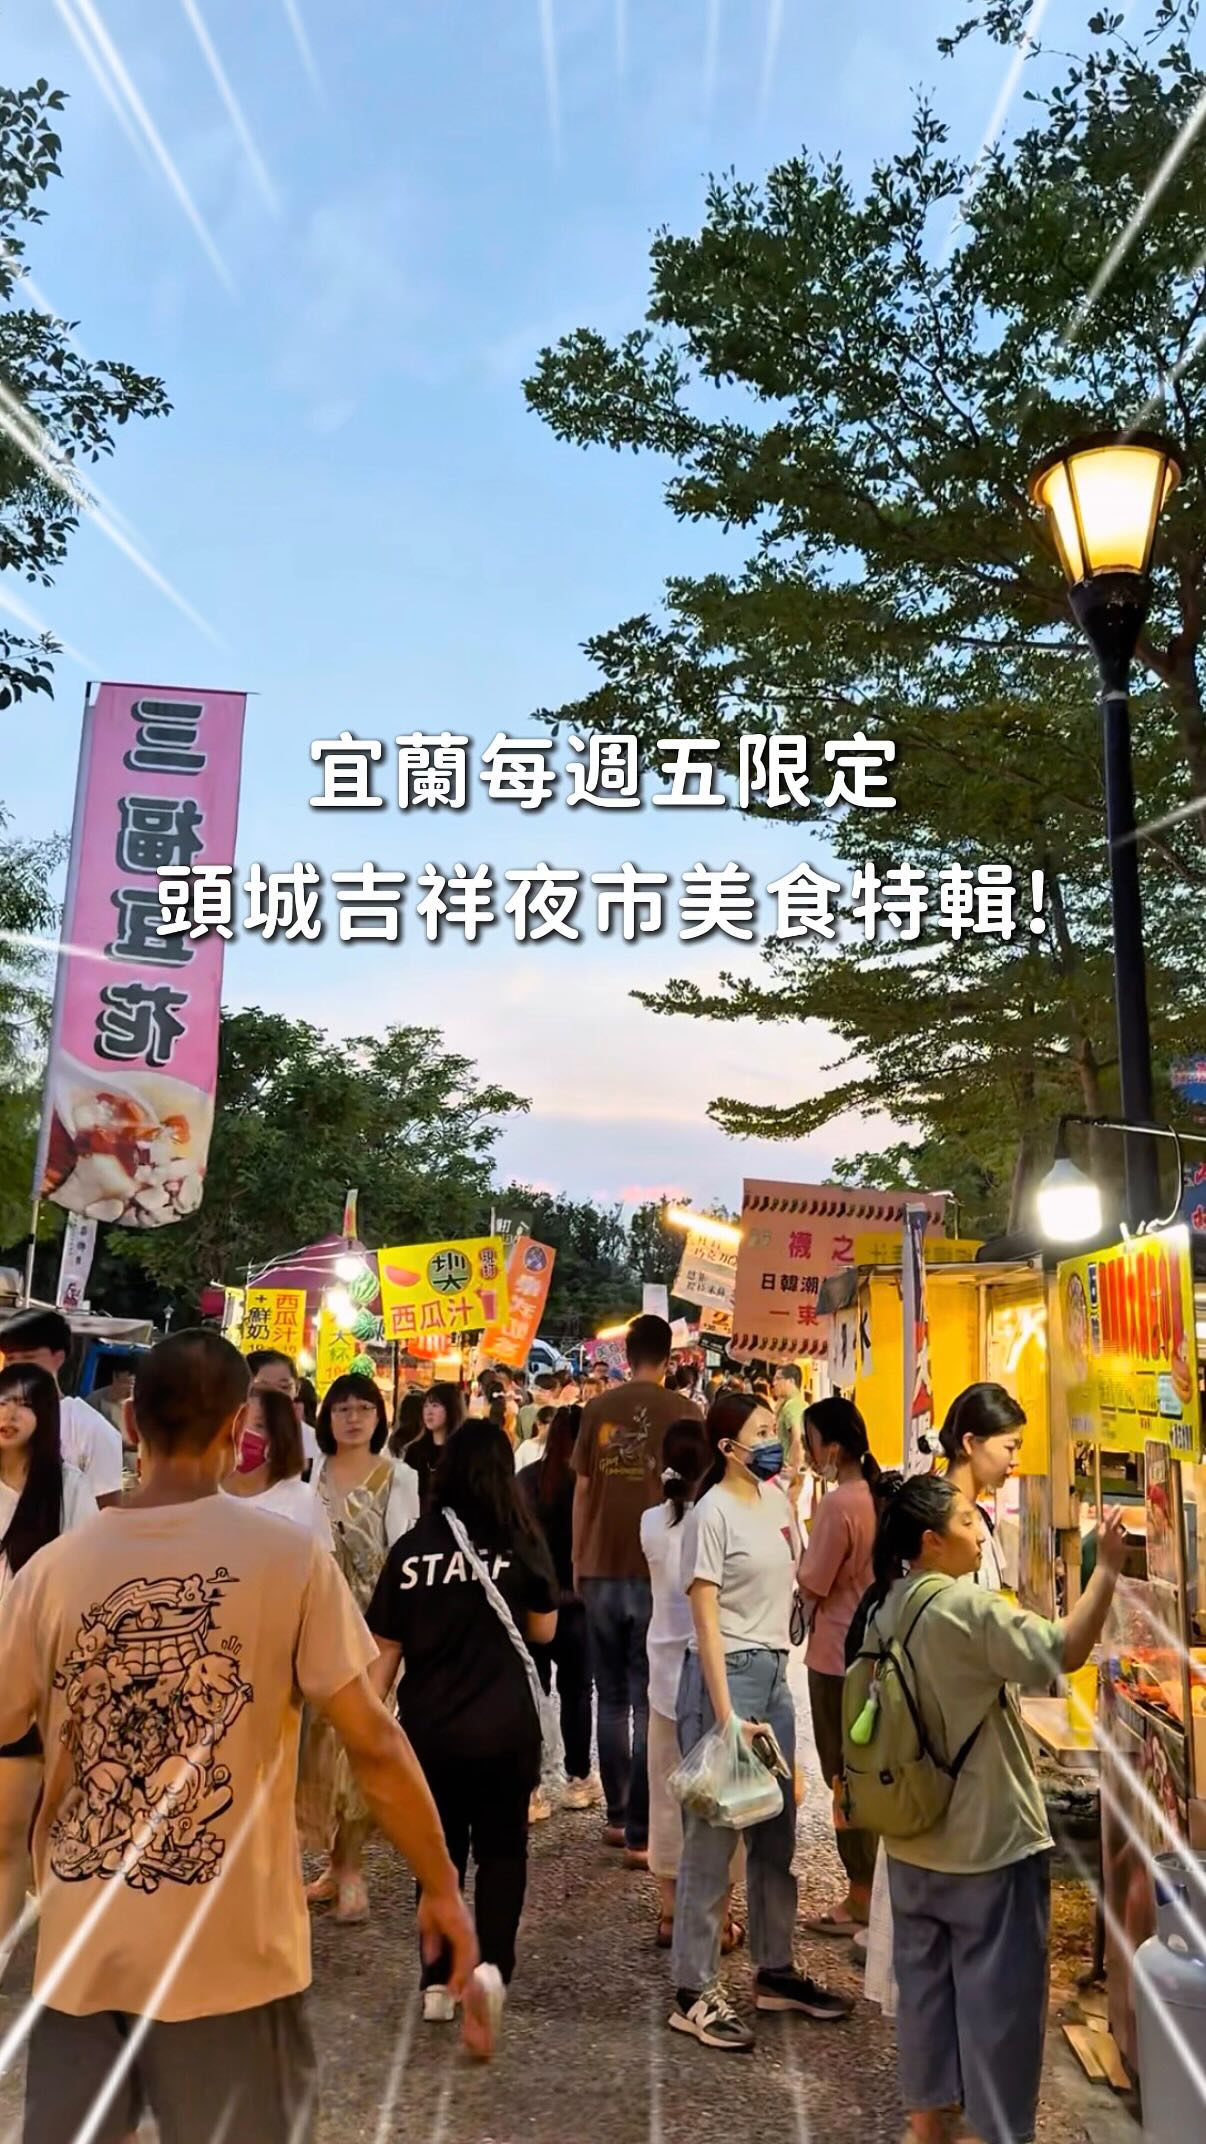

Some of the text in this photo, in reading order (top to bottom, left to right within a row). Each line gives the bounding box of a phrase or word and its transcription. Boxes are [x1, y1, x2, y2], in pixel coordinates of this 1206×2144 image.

[760, 1273, 825, 1295] 日韓潮
[273, 1294, 299, 1342] 西瓜汁
[390, 1297, 474, 1334] 西瓜汁
